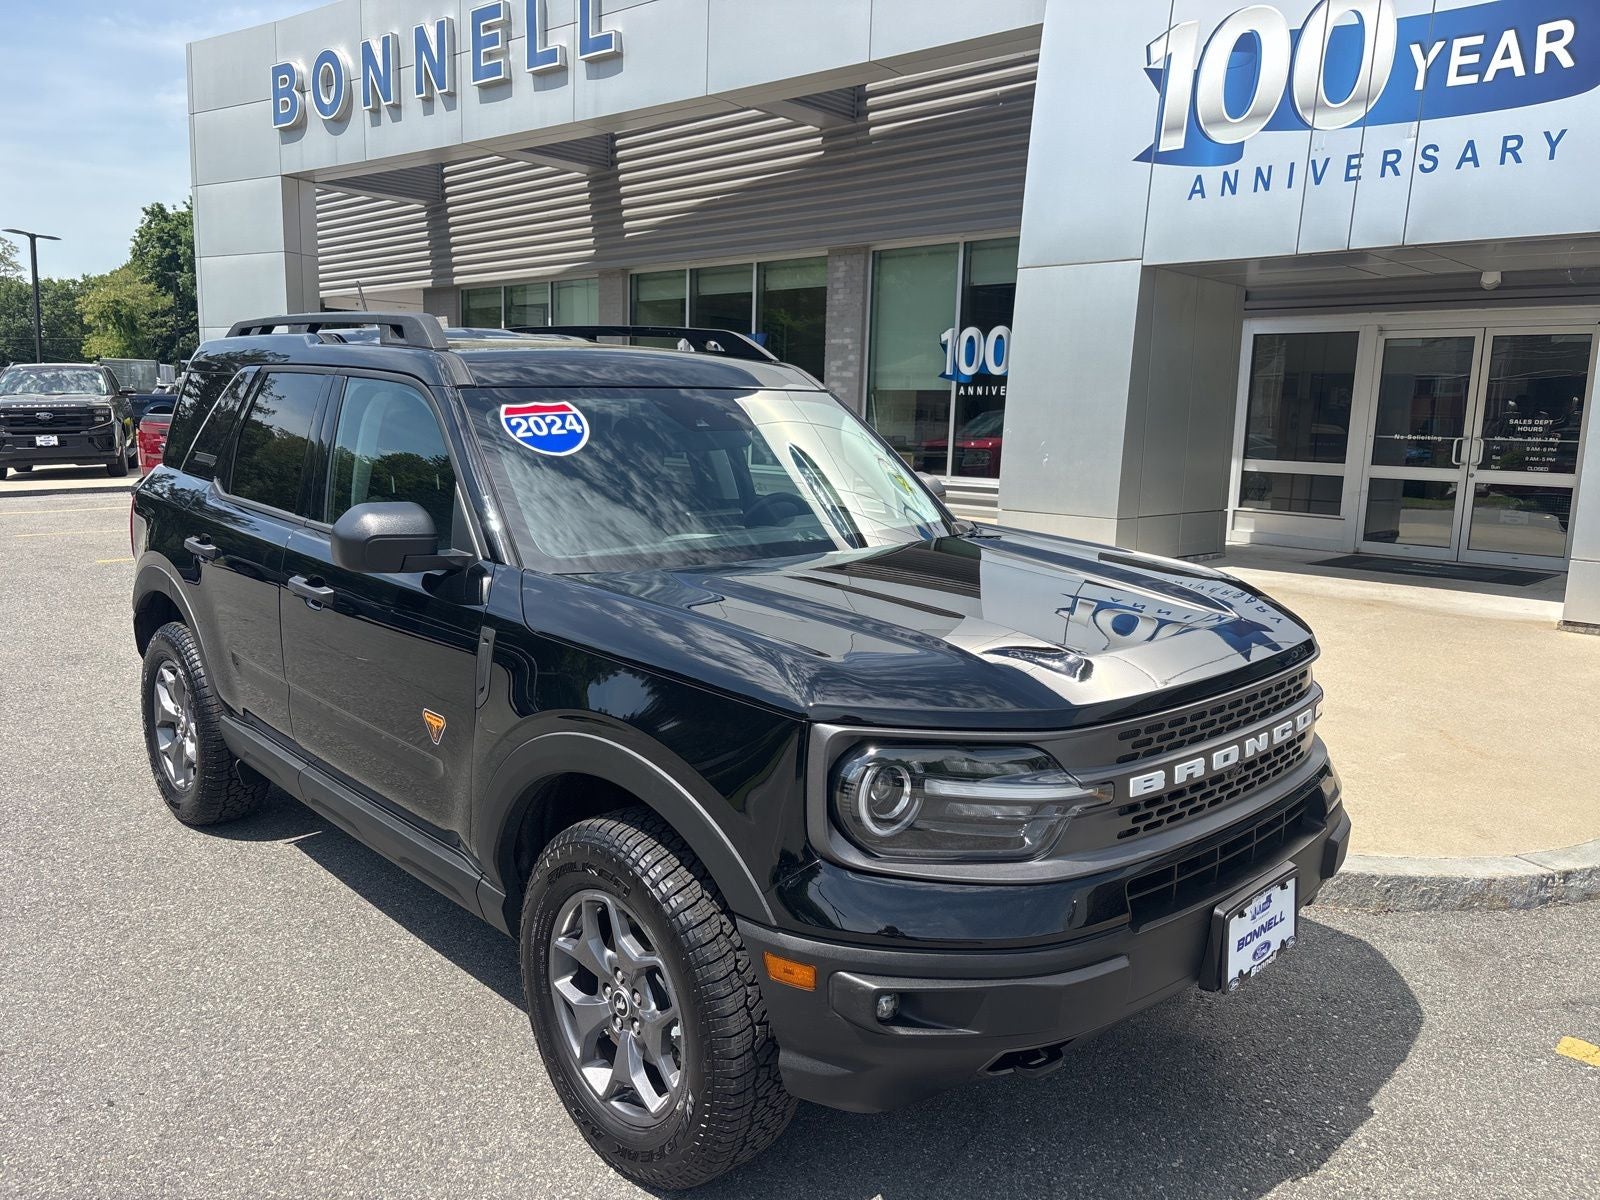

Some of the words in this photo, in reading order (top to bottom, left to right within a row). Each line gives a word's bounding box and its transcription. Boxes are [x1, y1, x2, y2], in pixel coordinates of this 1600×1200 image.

[270, 0, 623, 129] BONNELL
[1147, 0, 1398, 152] 100
[1408, 19, 1576, 91] YEAR
[1187, 129, 1568, 200] ANNIVERSARY
[940, 325, 1012, 375] 100
[959, 386, 1006, 396] ANNIVE
[510, 414, 583, 438] 2024
[1130, 709, 1312, 798] BRONCO
[1237, 910, 1285, 953] BONNELL
